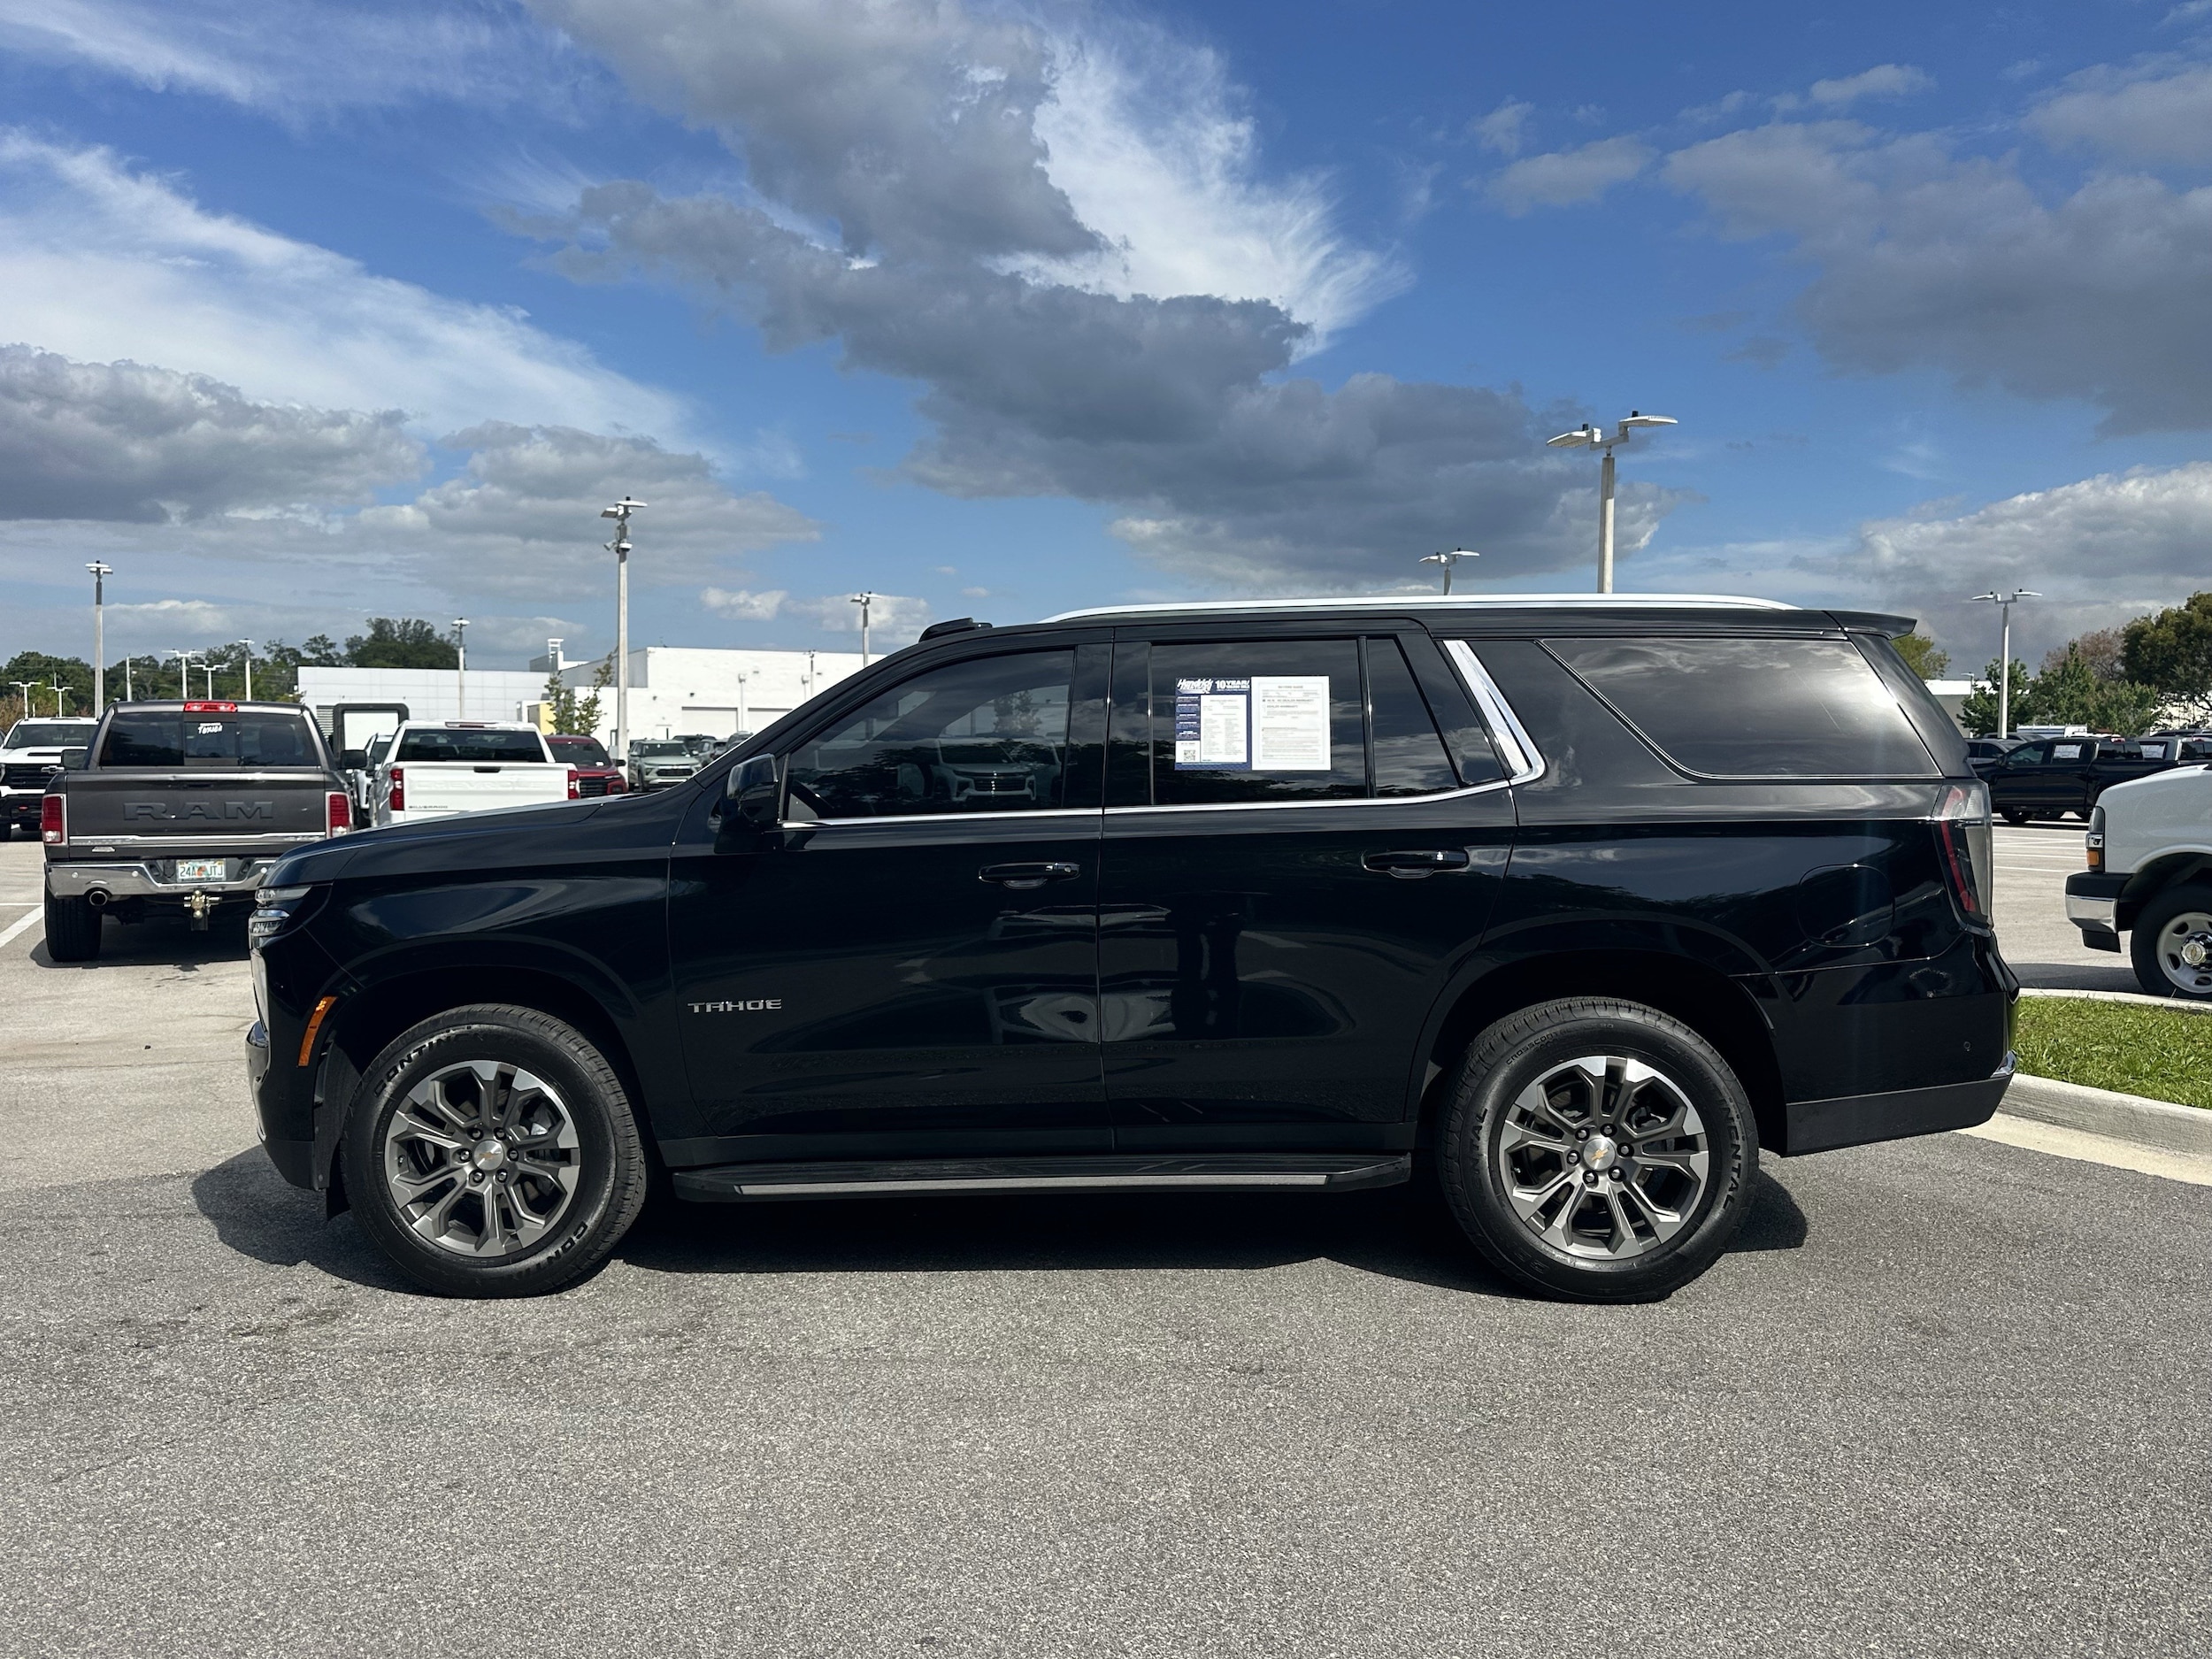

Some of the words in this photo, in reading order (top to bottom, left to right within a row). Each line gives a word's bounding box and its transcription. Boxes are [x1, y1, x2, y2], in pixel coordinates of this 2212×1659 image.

[1215, 680, 1226, 689] 10
[123, 801, 274, 821] RAM
[687, 998, 782, 1014] TAHOE
